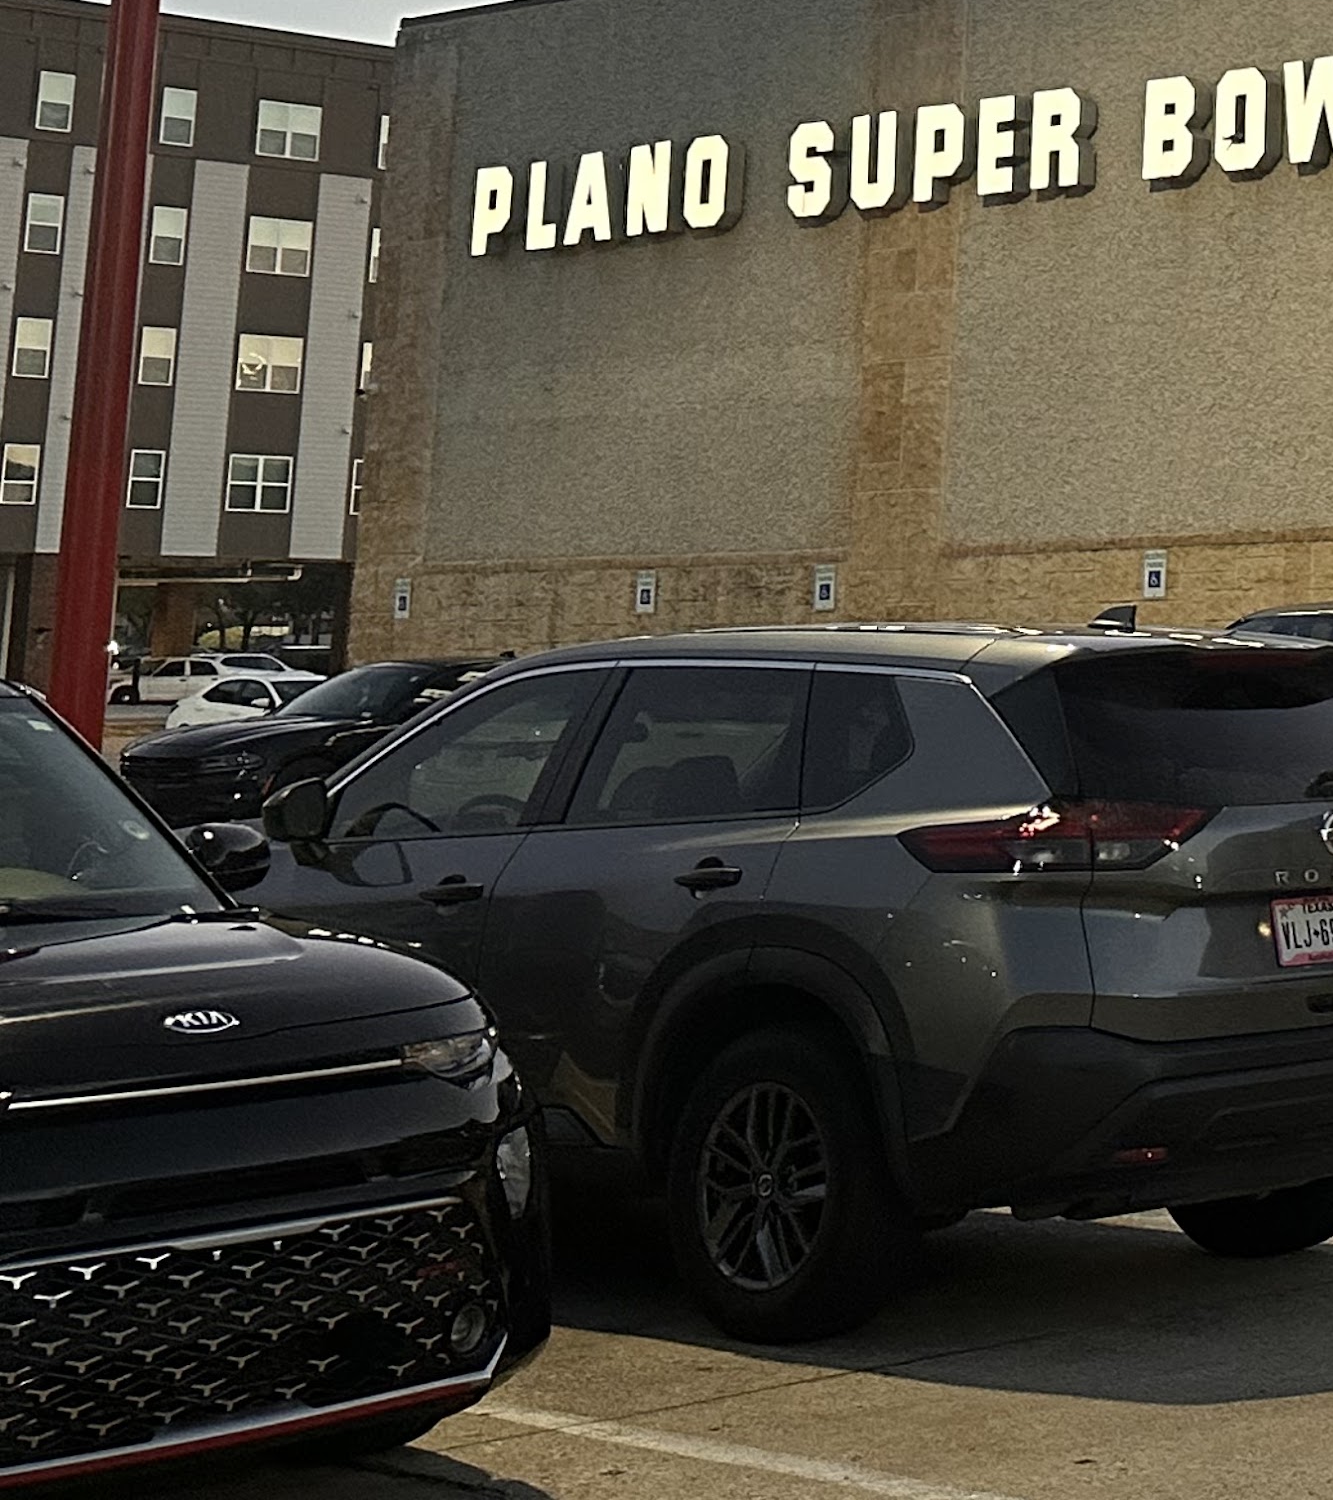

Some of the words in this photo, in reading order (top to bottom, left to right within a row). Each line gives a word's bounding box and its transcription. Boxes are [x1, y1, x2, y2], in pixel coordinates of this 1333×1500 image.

[471, 134, 729, 257] PLANO
[787, 87, 1081, 217] SUPER
[175, 1010, 230, 1028] KIA
